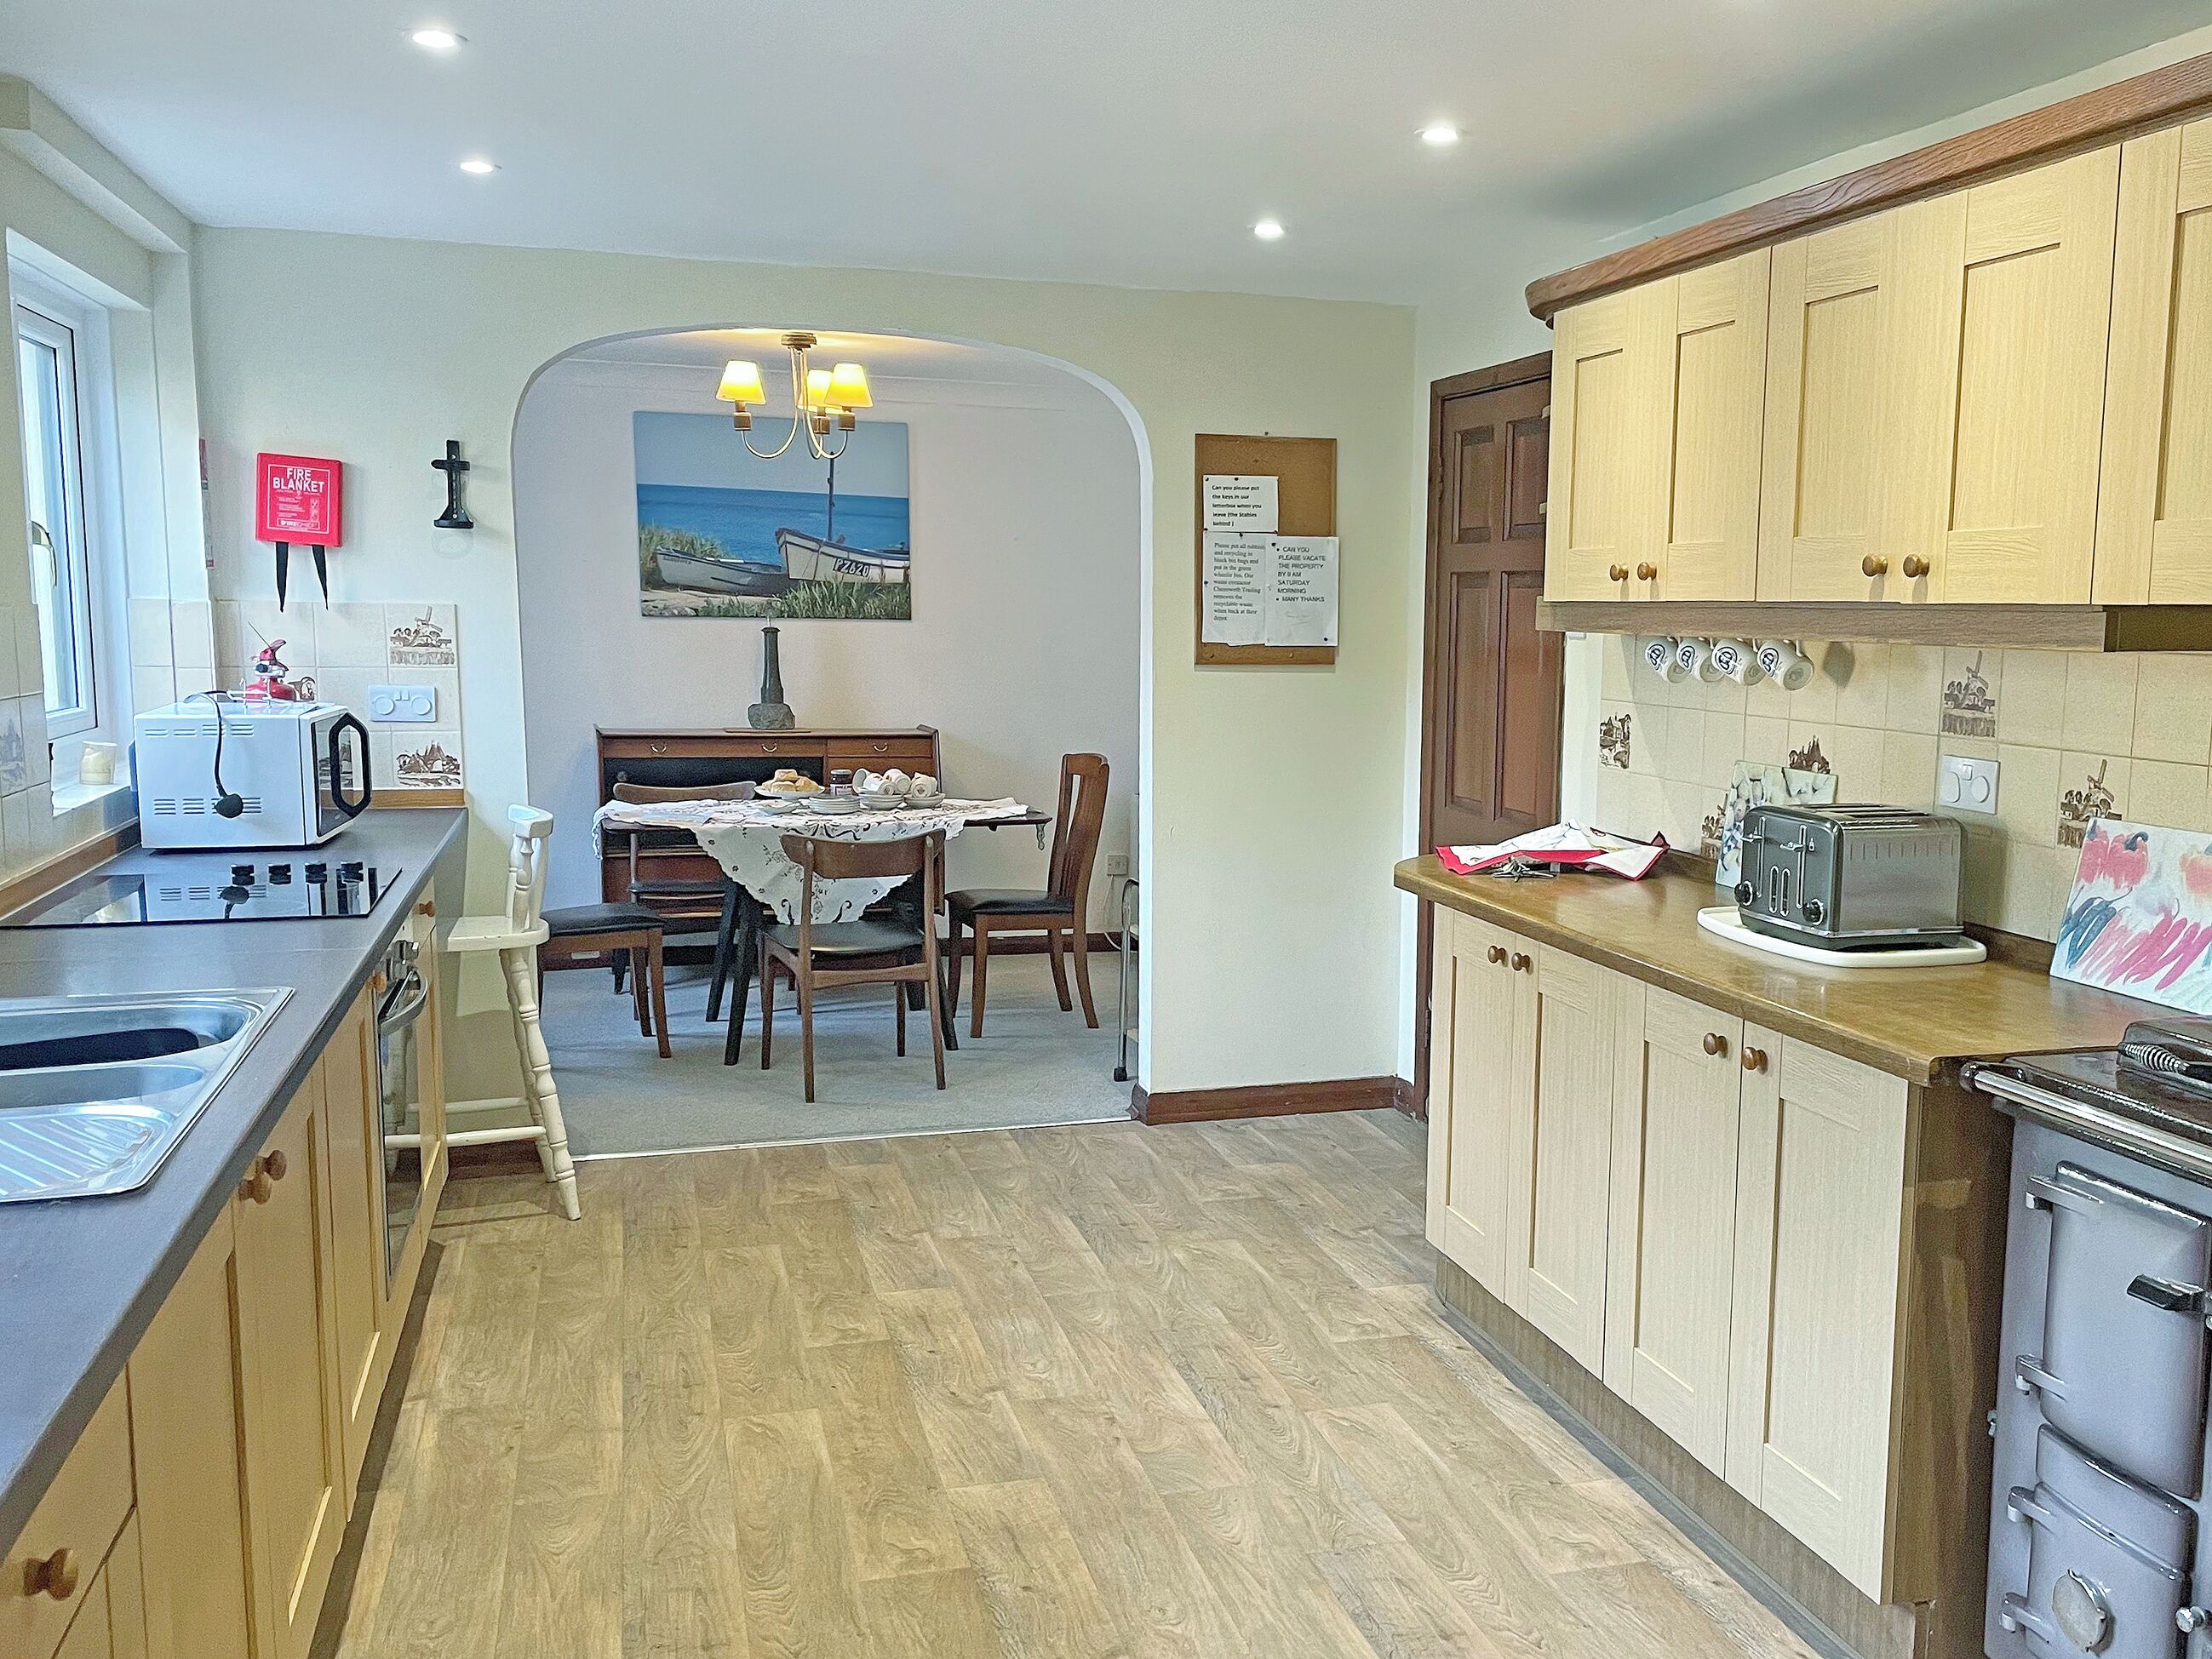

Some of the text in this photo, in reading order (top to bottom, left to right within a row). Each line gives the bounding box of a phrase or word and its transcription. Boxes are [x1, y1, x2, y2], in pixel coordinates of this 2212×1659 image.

[287, 467, 312, 480] FIRE
[272, 477, 325, 493] BLANKET
[834, 559, 869, 577] PZ620
